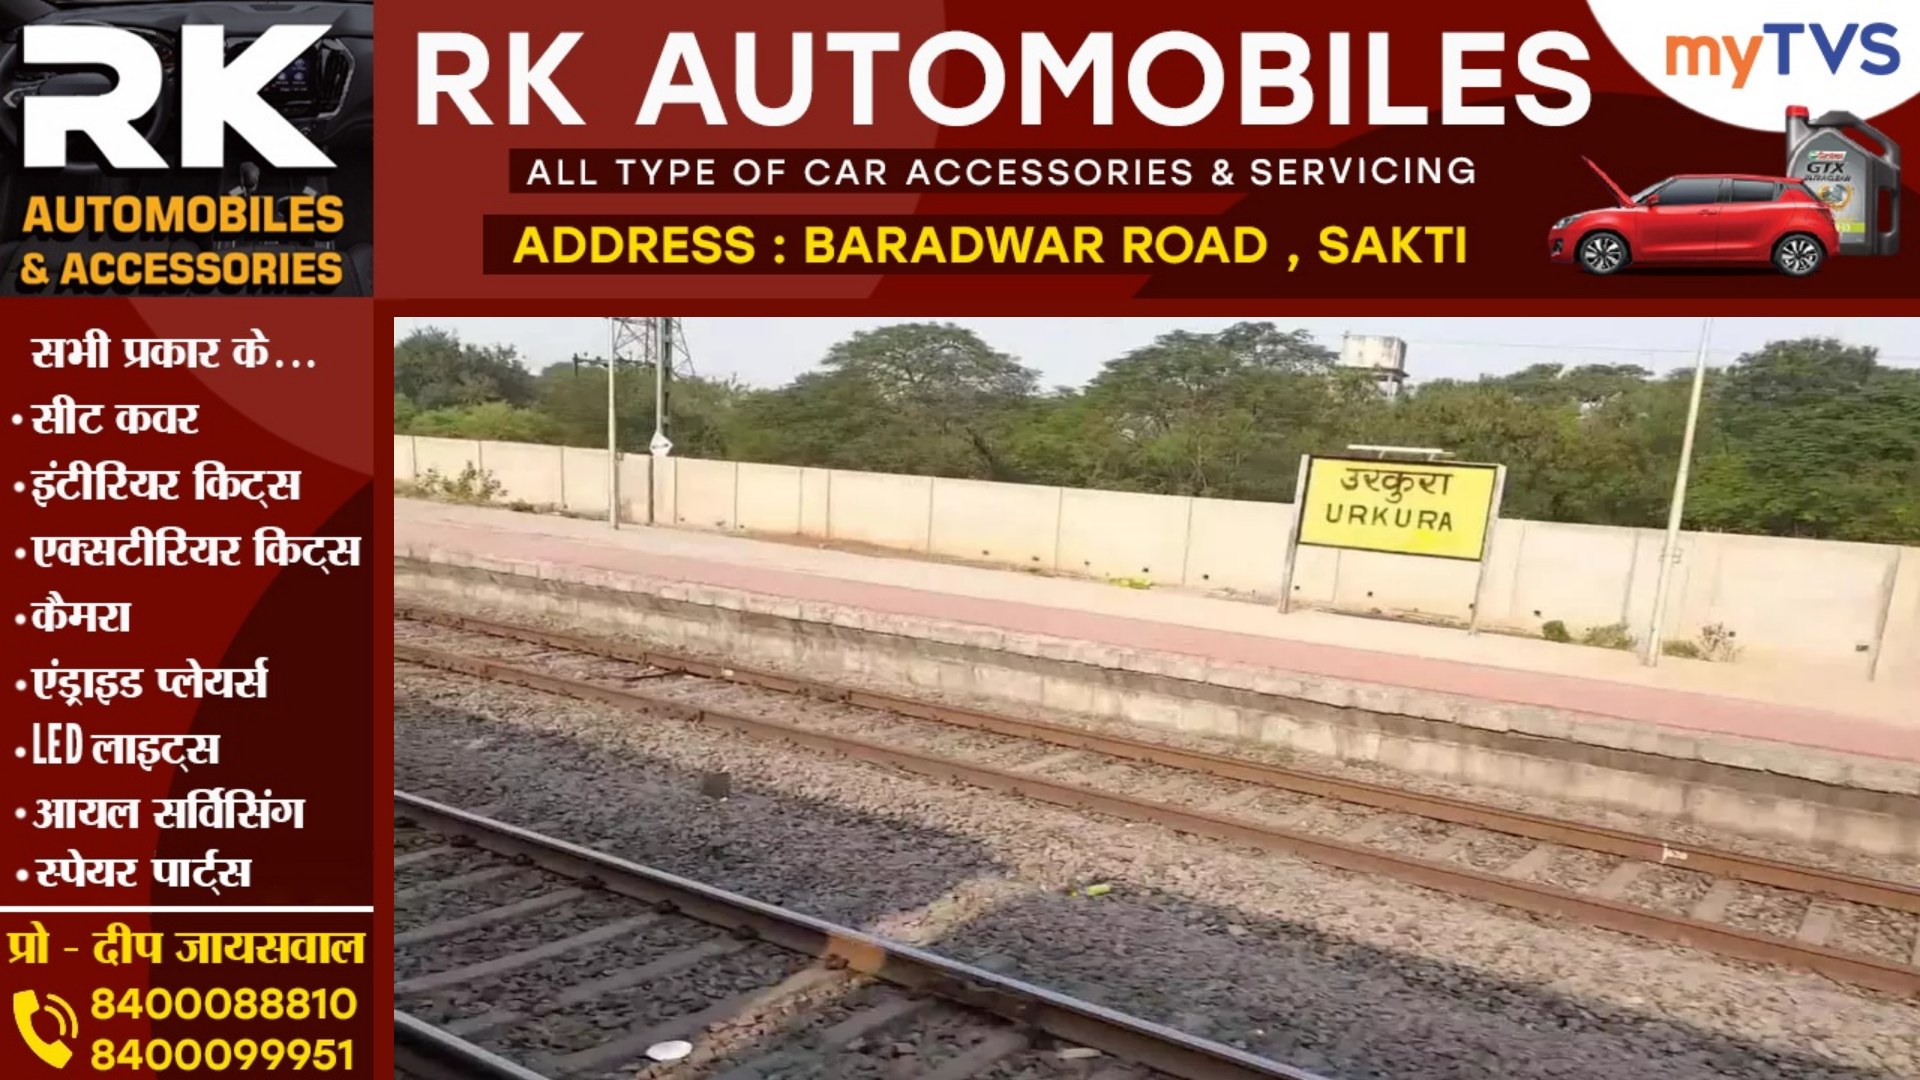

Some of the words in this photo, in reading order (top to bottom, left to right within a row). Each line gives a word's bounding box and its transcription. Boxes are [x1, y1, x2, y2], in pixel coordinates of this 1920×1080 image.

[1807, 161, 1846, 174] GTX
[1340, 467, 1454, 504] उरकुरा
[1325, 503, 1453, 532] URKURA
